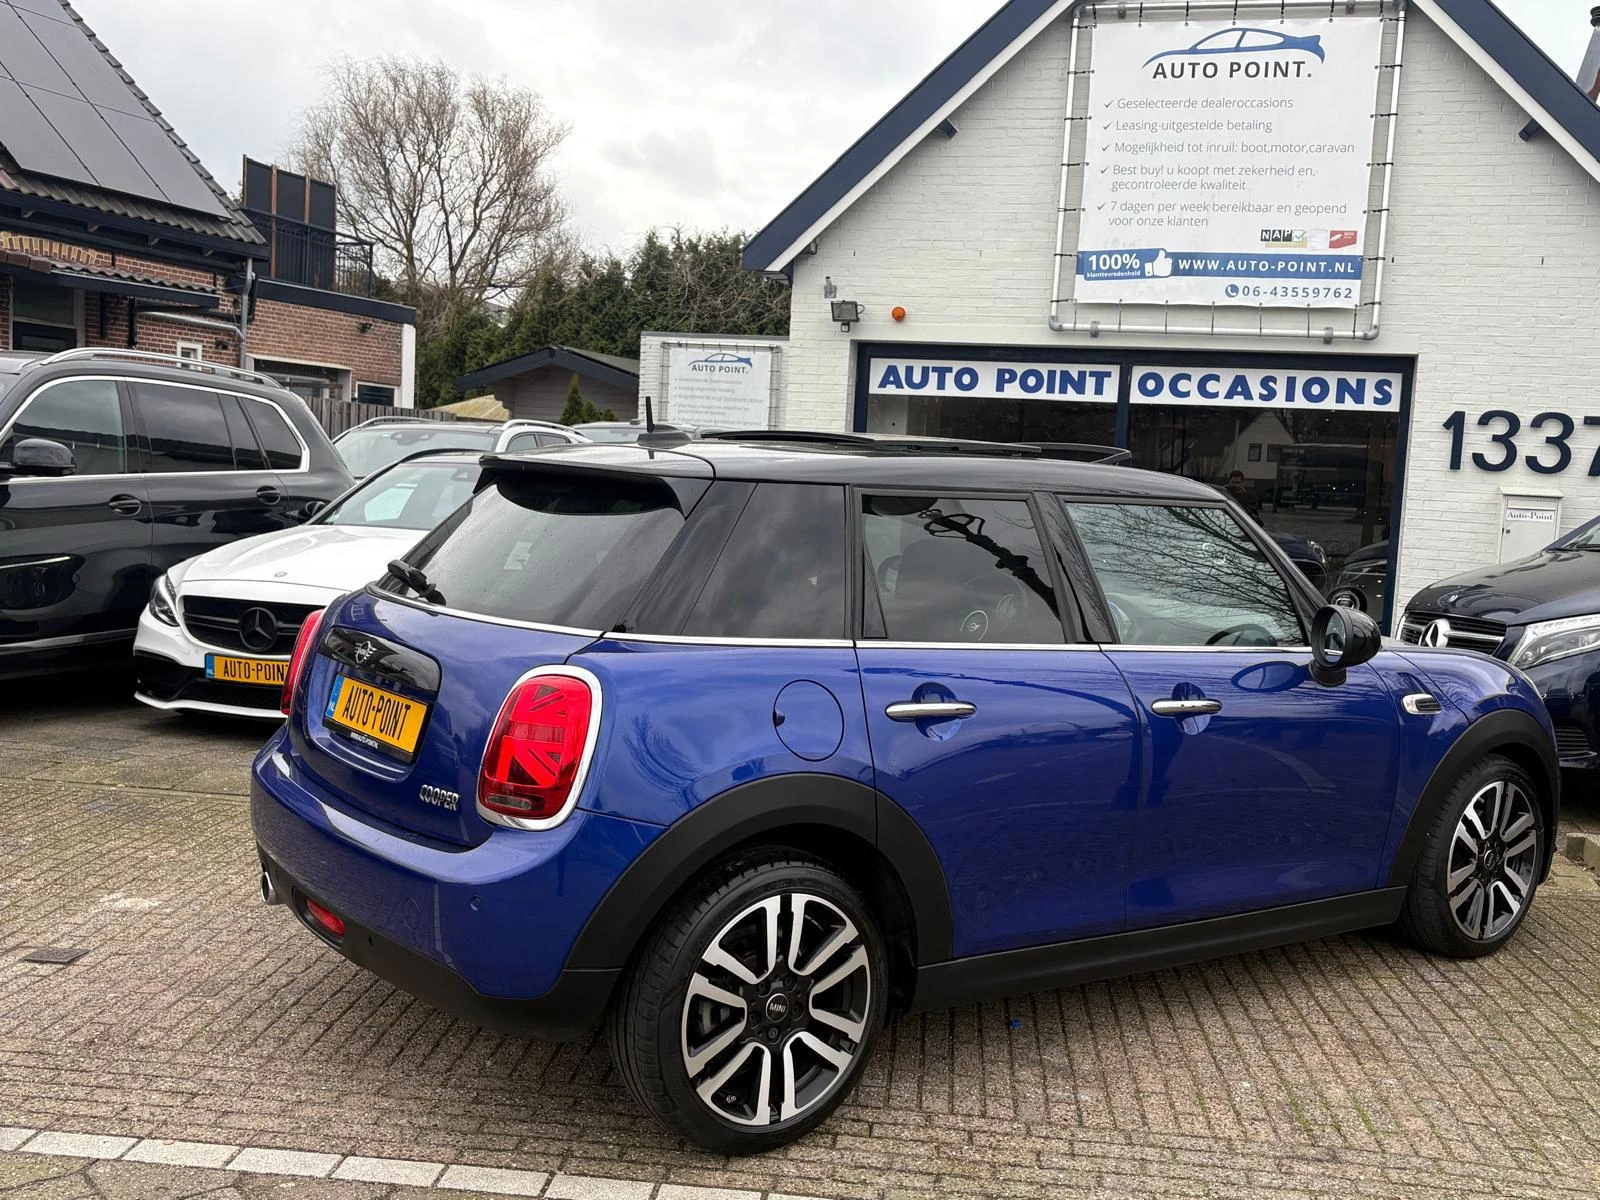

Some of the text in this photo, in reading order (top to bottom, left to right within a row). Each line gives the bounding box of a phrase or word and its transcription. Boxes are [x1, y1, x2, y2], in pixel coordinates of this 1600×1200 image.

[1152, 60, 1312, 79] AUTO POINT.
[1117, 97, 1294, 109] Geselecteerde dealeroccasions
[1116, 119, 1272, 133] Leasing-uitgestelde betaling
[1114, 141, 1355, 155] Mogelijkheid tot inruil: boot,motor,caravan
[1113, 164, 1138, 175] Best
[1140, 164, 1164, 177] buy!
[1166, 166, 1175, 175] u
[1177, 165, 1210, 177] koopt
[1213, 166, 1236, 176] met
[1238, 165, 1295, 176] zekerheid
[1111, 179, 1247, 192] gecontroleerde kwaliteit
[1110, 201, 1347, 216] 7 dagen per week bereikbaar en geopend
[1109, 215, 1209, 227] voor onze klanten
[1261, 229, 1292, 242] NAP
[1088, 253, 1140, 270] 100%
[1178, 259, 1355, 273] WWW.AUTO-POINT.NL
[1242, 285, 1353, 299] 06-43559762
[691, 364, 716, 373] AUTO
[878, 365, 1112, 396] AUTO POINT
[1137, 371, 1393, 405] OCCASIONS
[1506, 511, 1553, 521] Auto-Point
[223, 659, 289, 682] AUTO-POIN
[342, 685, 411, 741] AUTO-POINT
[419, 784, 459, 811] COOPER
